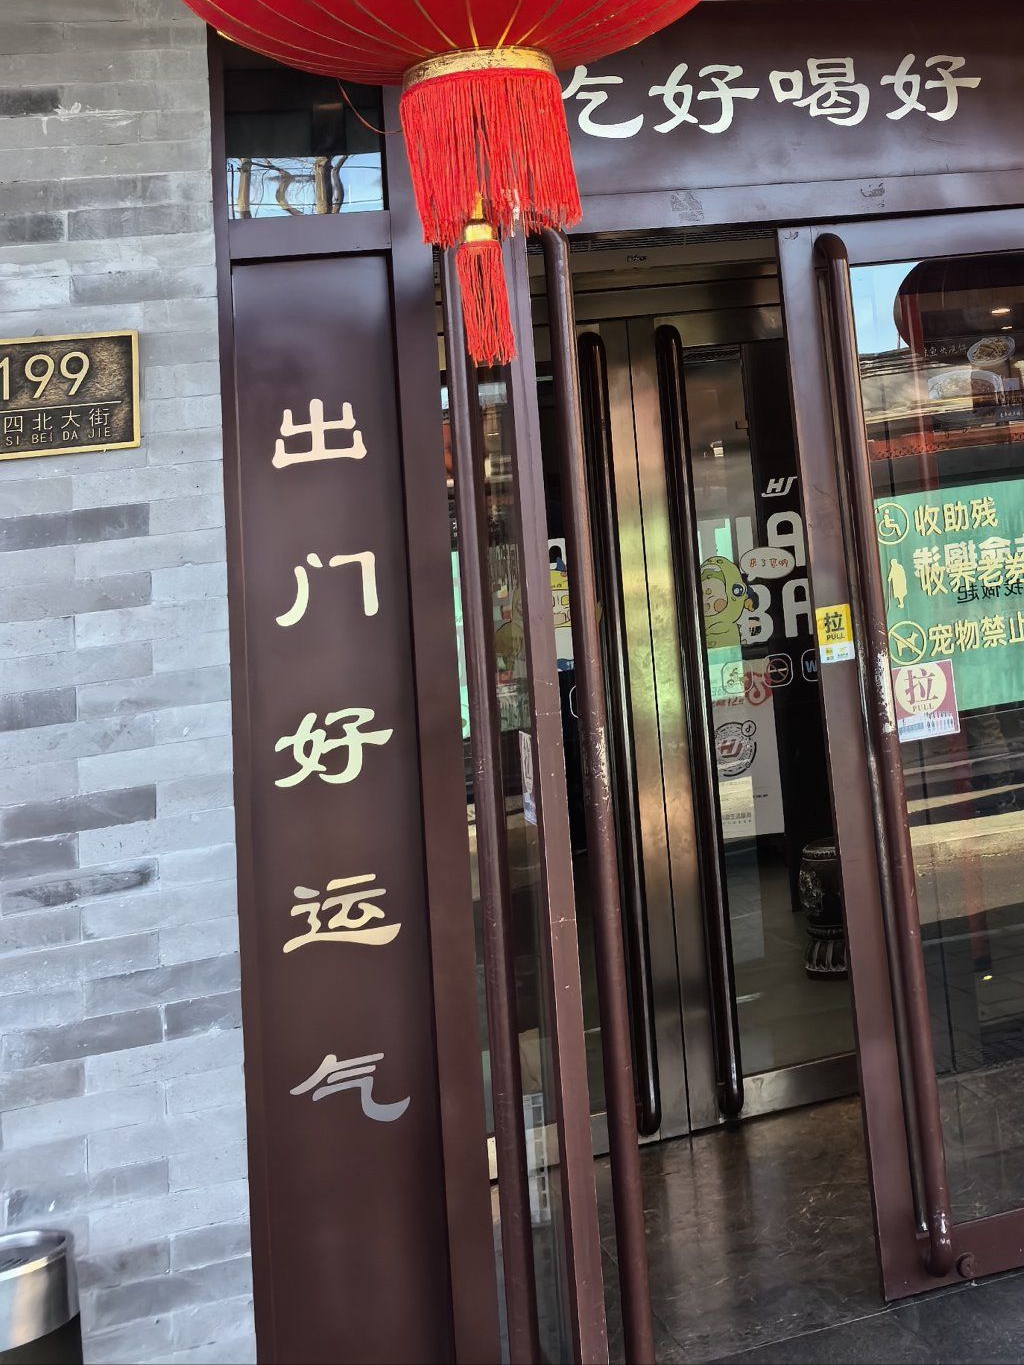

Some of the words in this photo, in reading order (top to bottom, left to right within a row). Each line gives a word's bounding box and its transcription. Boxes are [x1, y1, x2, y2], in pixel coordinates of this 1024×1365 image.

[4, 407, 110, 434] 四北大街
[5, 435, 20, 446] SI
[31, 432, 53, 444] BEI
[62, 430, 79, 441] DA
[88, 426, 111, 439] JIE
[824, 611, 845, 633] 拉
[826, 632, 845, 641] PULL
[904, 667, 939, 705] 拉
[912, 703, 935, 712] PULL
[272, 398, 411, 1121] 出门好运气
